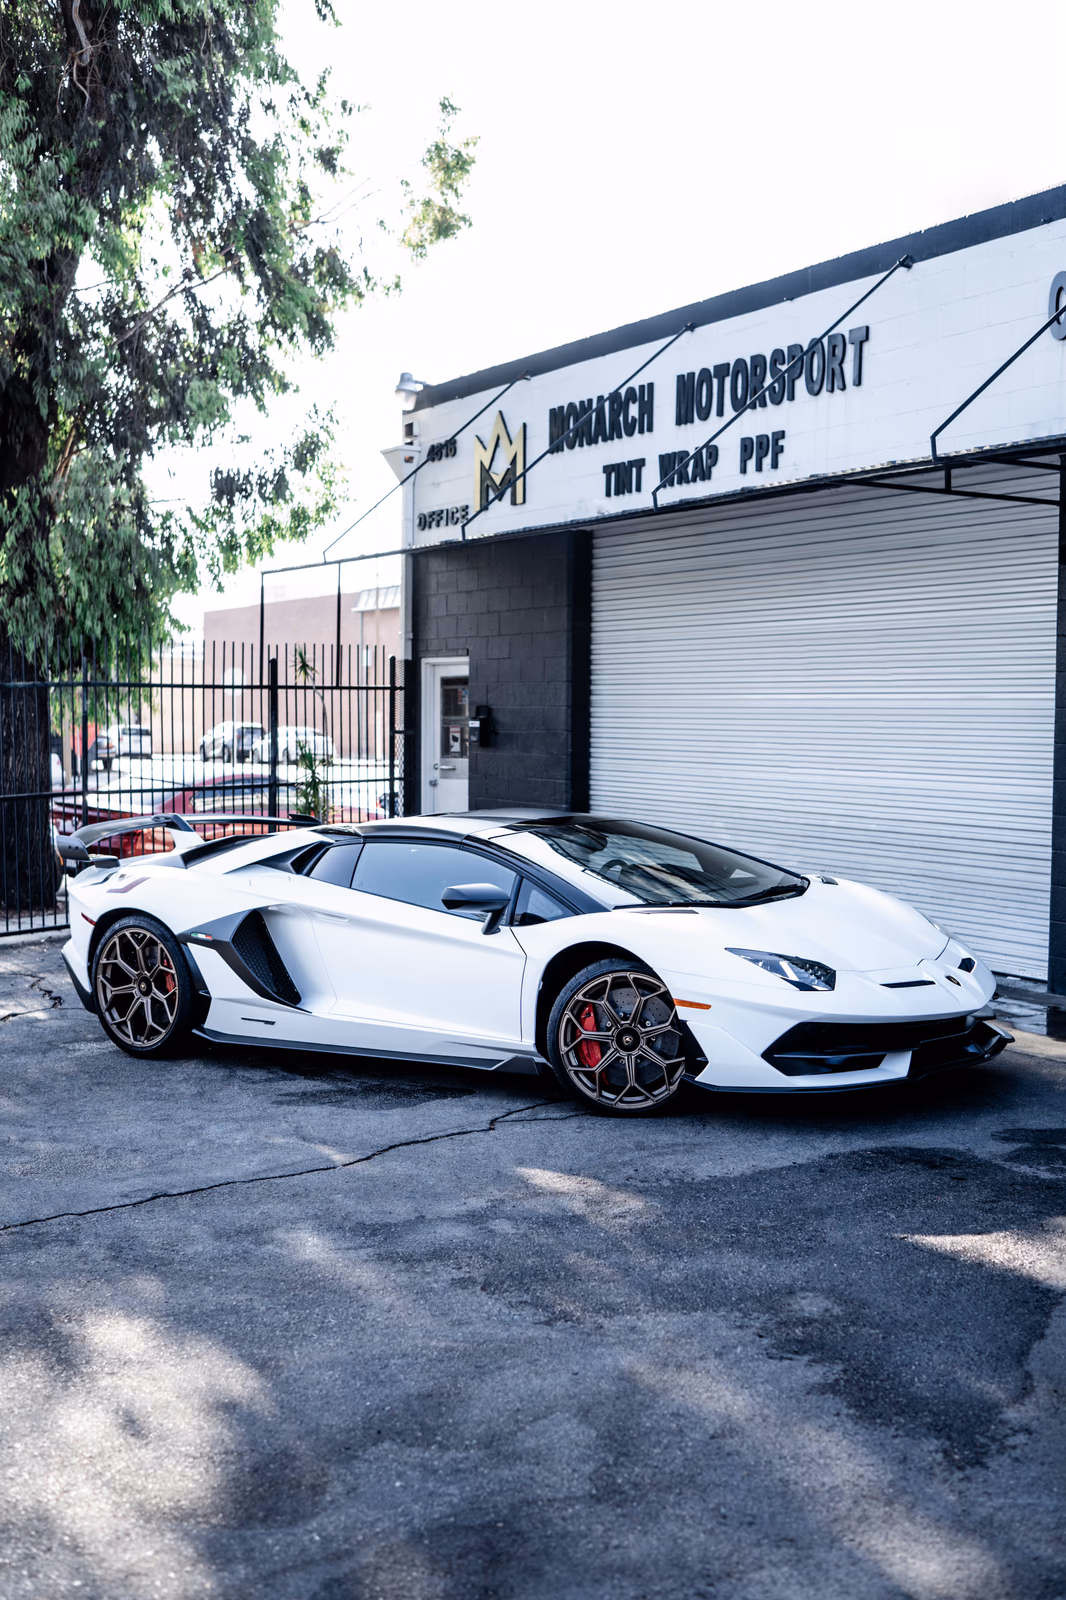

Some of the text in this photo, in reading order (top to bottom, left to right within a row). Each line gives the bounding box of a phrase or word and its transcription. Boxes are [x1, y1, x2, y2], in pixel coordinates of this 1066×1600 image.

[549, 326, 869, 454] MONARCH MOTORSPORT
[603, 430, 785, 497] TINT WRAP PPF
[417, 505, 469, 531] OFFICE
